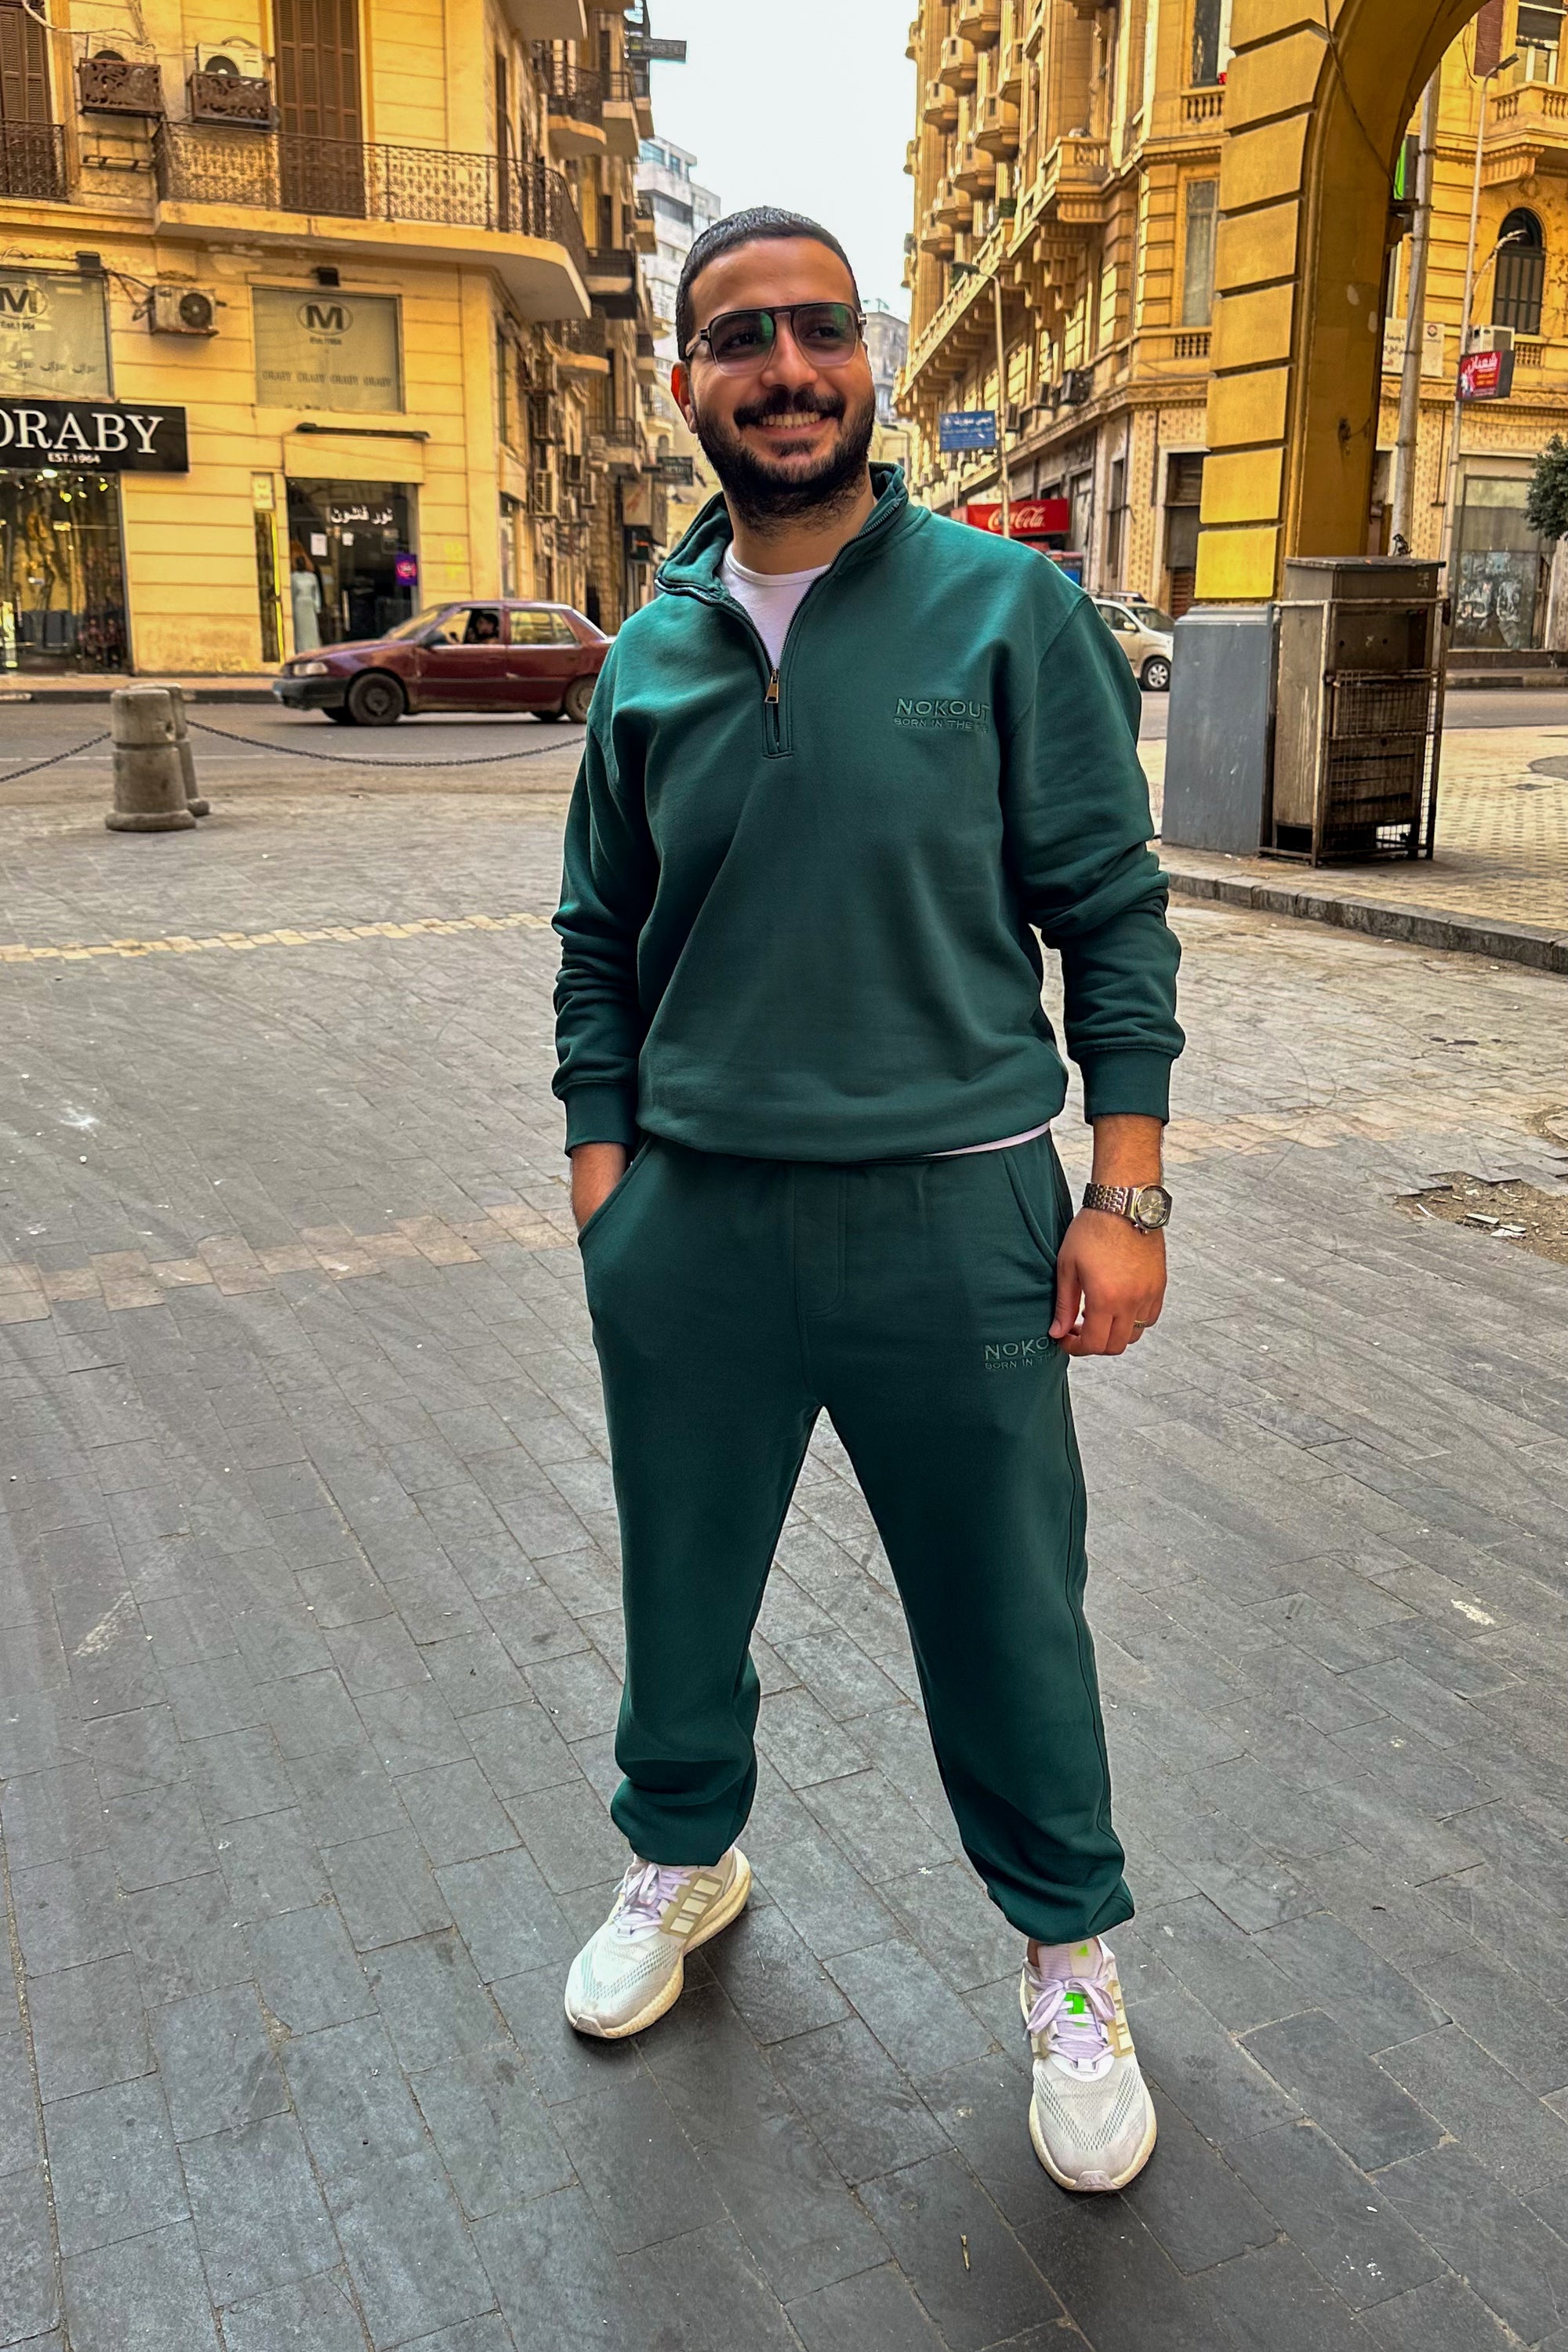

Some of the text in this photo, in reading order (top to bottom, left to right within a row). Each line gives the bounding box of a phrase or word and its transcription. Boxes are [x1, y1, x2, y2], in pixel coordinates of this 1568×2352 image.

[307, 305, 343, 330] M
[372, 507, 394, 524] نور
[895, 698, 990, 720] NOKOUT
[894, 717, 927, 728] BORN
[947, 720, 973, 729] THE
[985, 1336, 1052, 1360] NOKO
[985, 1361, 1017, 1370] BORN
[1022, 1358, 1033, 1367] IN
